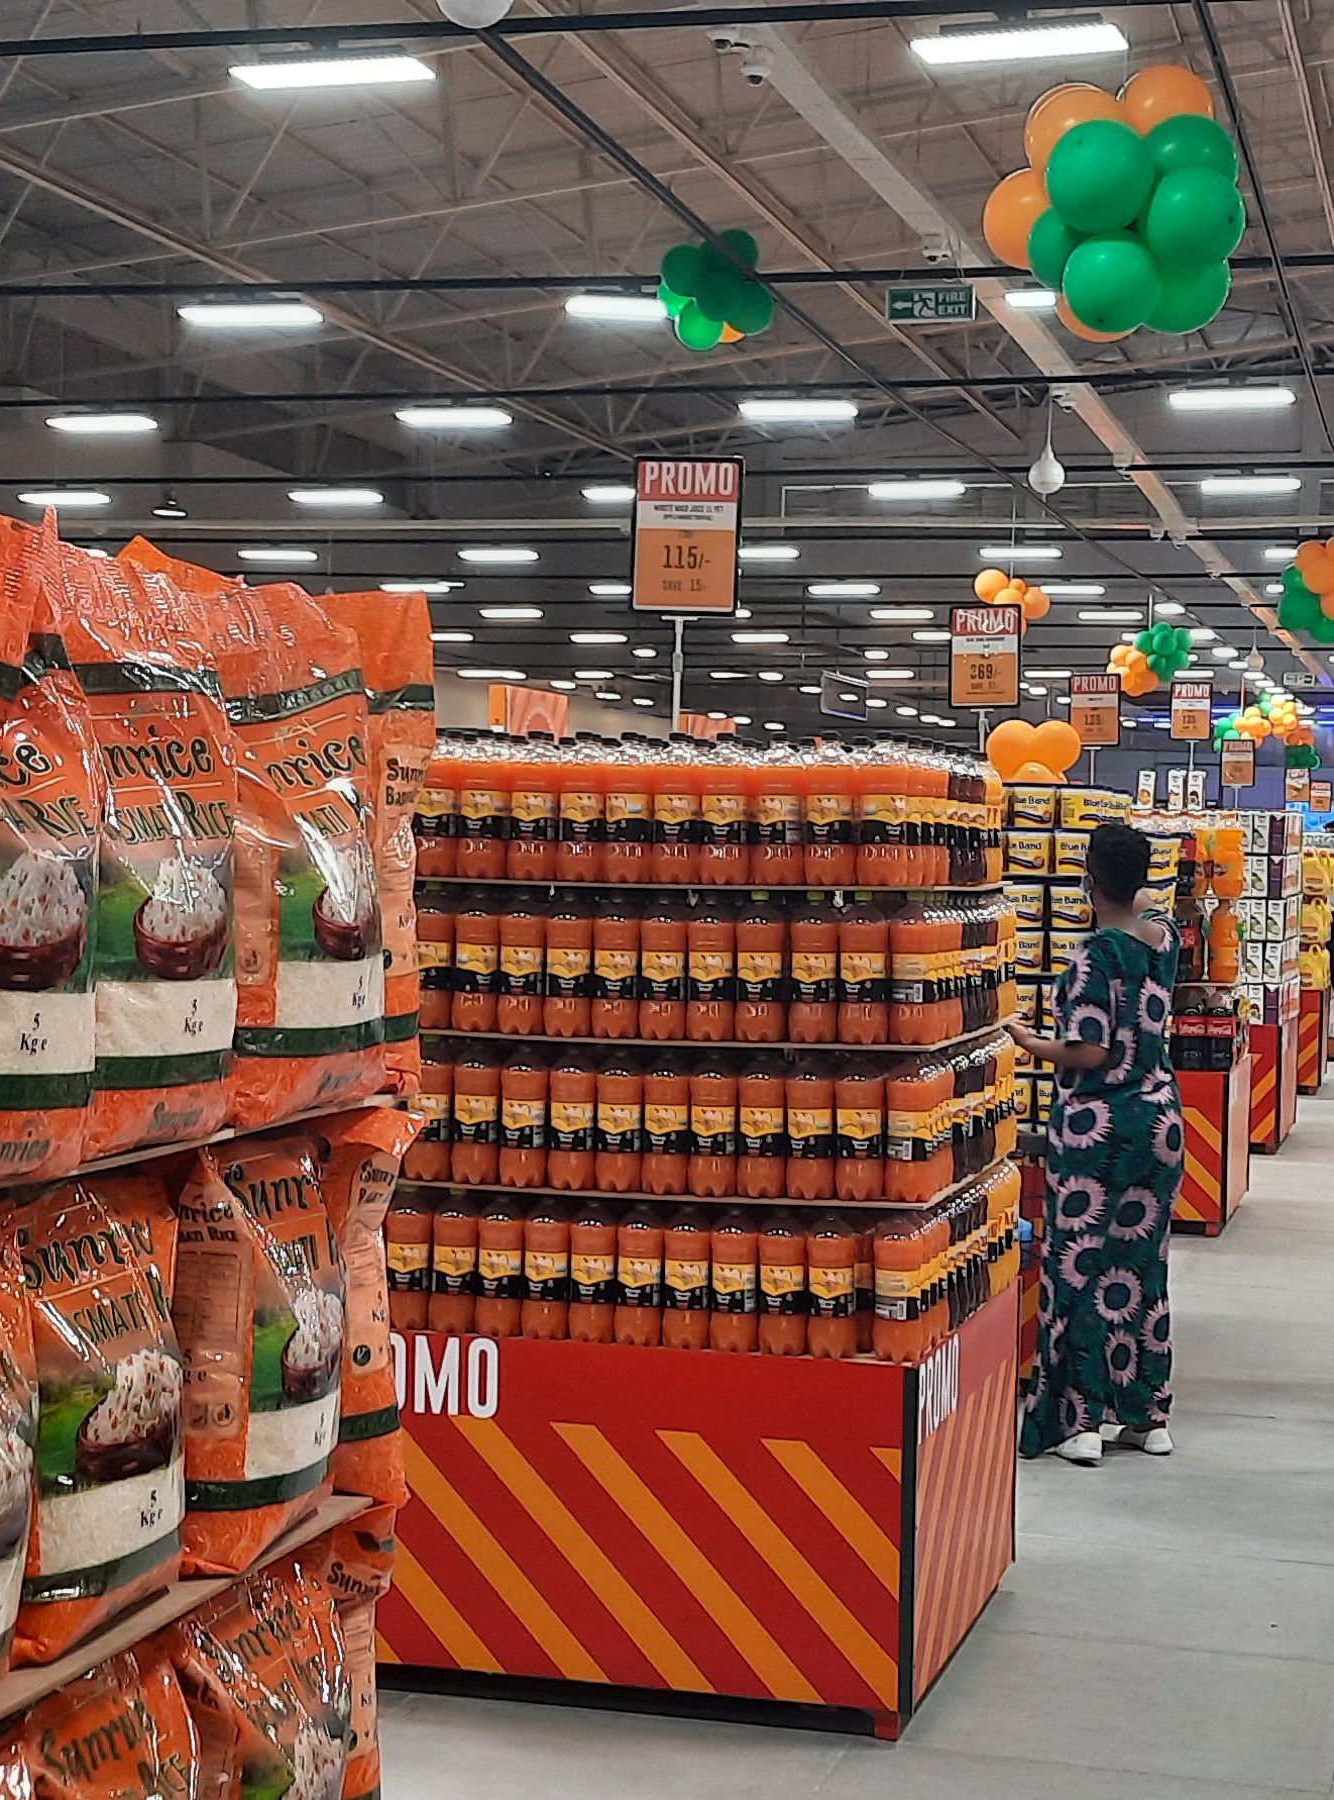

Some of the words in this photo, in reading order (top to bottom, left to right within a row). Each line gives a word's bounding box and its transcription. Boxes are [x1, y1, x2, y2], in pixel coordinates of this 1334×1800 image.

[938, 291, 966, 303] FIRE
[938, 304, 967, 316] EXIT
[644, 462, 734, 496] PROMO
[954, 608, 1017, 634] PROMO
[1073, 676, 1117, 692] PROMO
[1174, 684, 1210, 698] PROMO
[103, 723, 215, 785] nrice
[267, 735, 367, 793] nrice
[174, 791, 233, 838] RICE
[1019, 842, 1042, 850] Band
[191, 999, 198, 1015] 5
[33, 1013, 42, 1032] 5
[183, 1017, 198, 1035] Kg
[20, 1033, 39, 1055] Kg
[73, 1291, 149, 1348] SMATI
[917, 1332, 961, 1446] PROMO
